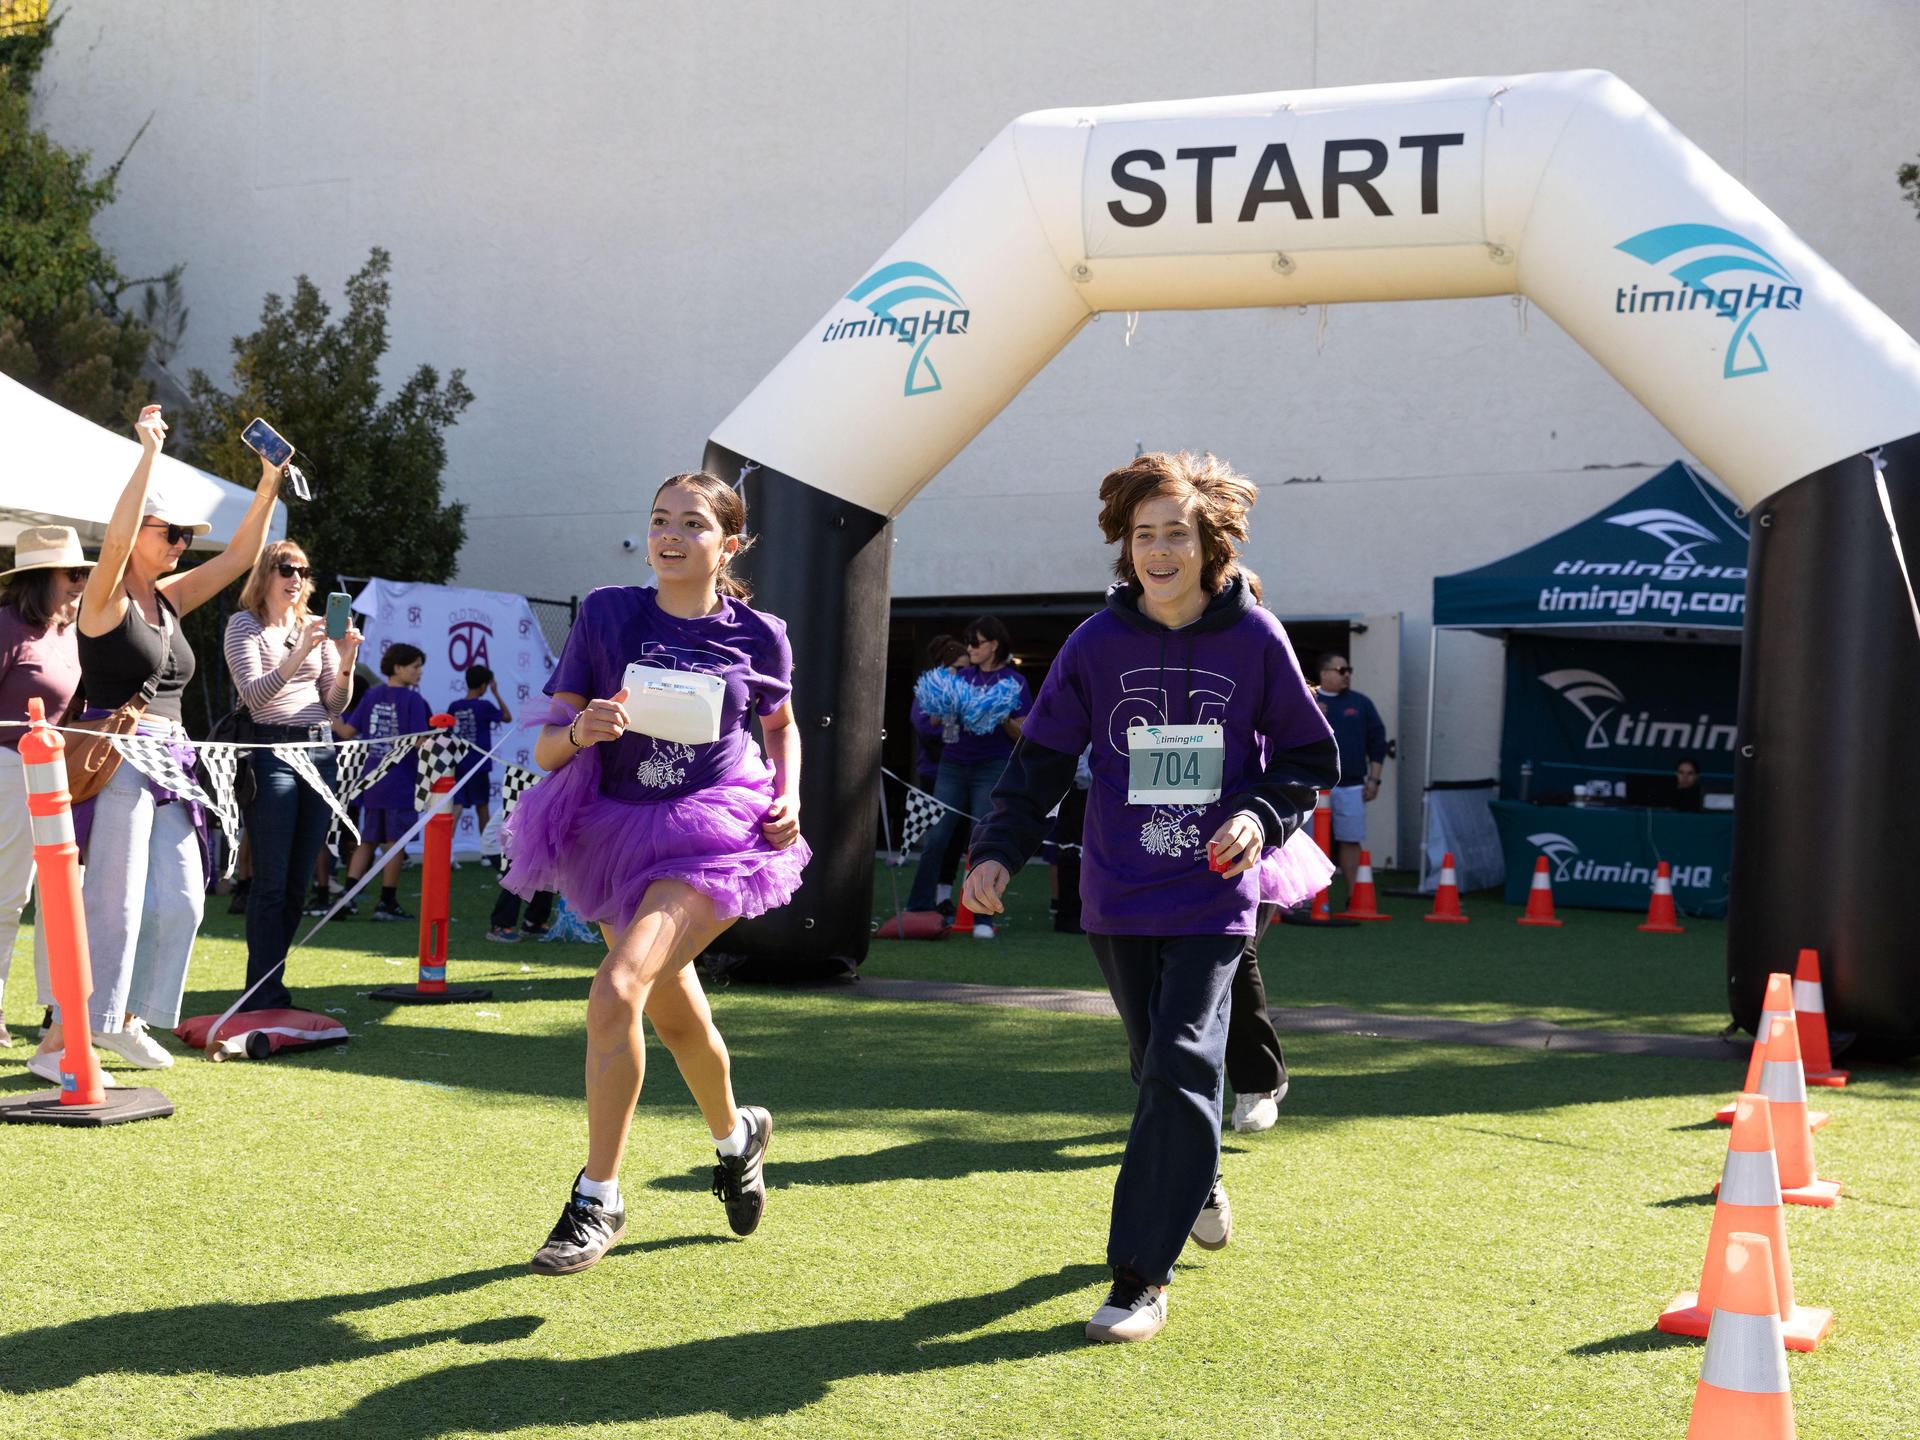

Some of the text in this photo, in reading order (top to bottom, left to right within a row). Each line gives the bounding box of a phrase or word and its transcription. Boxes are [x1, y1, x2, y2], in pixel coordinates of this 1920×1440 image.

[1106, 132, 1465, 227] START
[1615, 281, 1803, 318] timingHQ
[822, 309, 970, 343] timingHQ
[450, 608, 467, 624] OLD
[1160, 733, 1204, 745] timingHQ
[1150, 751, 1201, 787] 704
